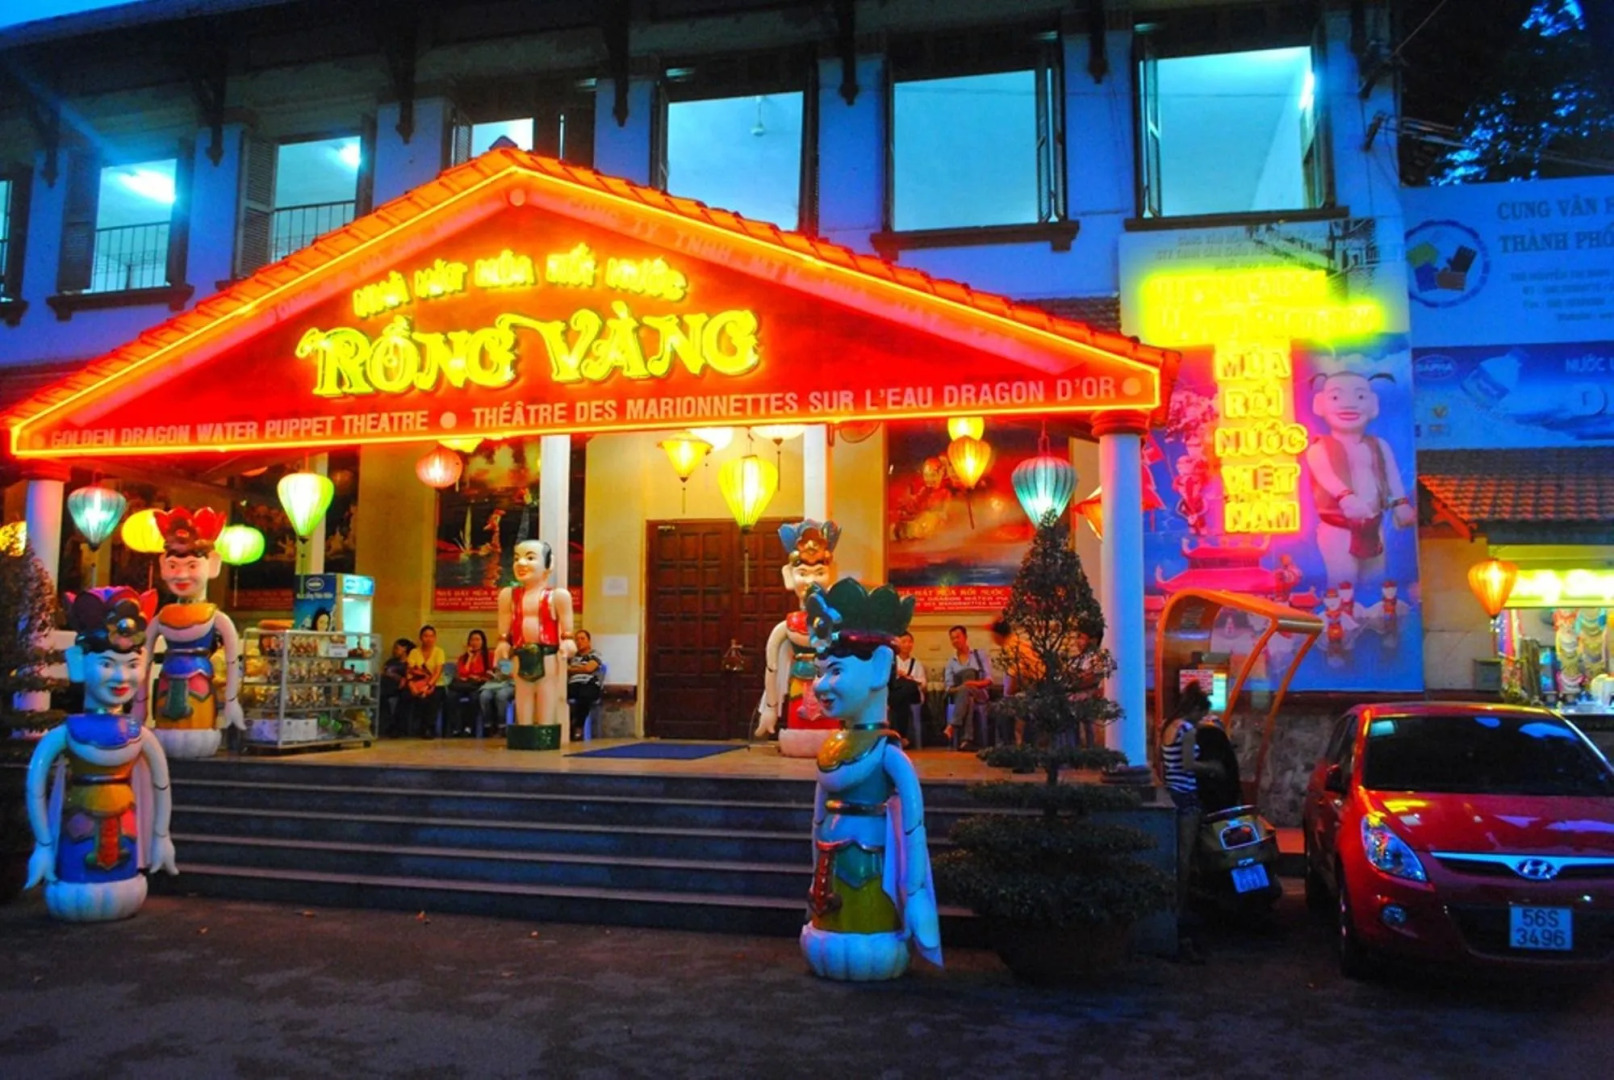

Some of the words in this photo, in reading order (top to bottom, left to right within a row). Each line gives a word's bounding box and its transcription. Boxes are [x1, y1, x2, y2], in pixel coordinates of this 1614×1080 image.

[1497, 201, 1550, 220] CUNG
[472, 402, 567, 428] THÉÂTRE
[575, 399, 618, 423] DES
[626, 392, 799, 420] MARIONNETTES
[808, 390, 854, 414] SUR
[865, 385, 934, 411] L'EAU
[944, 380, 1044, 408] DRAGON
[1056, 375, 1116, 401] D'OR
[51, 430, 115, 449] GOLDEN
[121, 425, 190, 447] DRAGON
[197, 420, 259, 442] WATER
[264, 415, 335, 440] PUPPET
[342, 410, 428, 434] THEATRE
[1522, 908, 1559, 927] 56S
[1515, 928, 1566, 948] 3496
